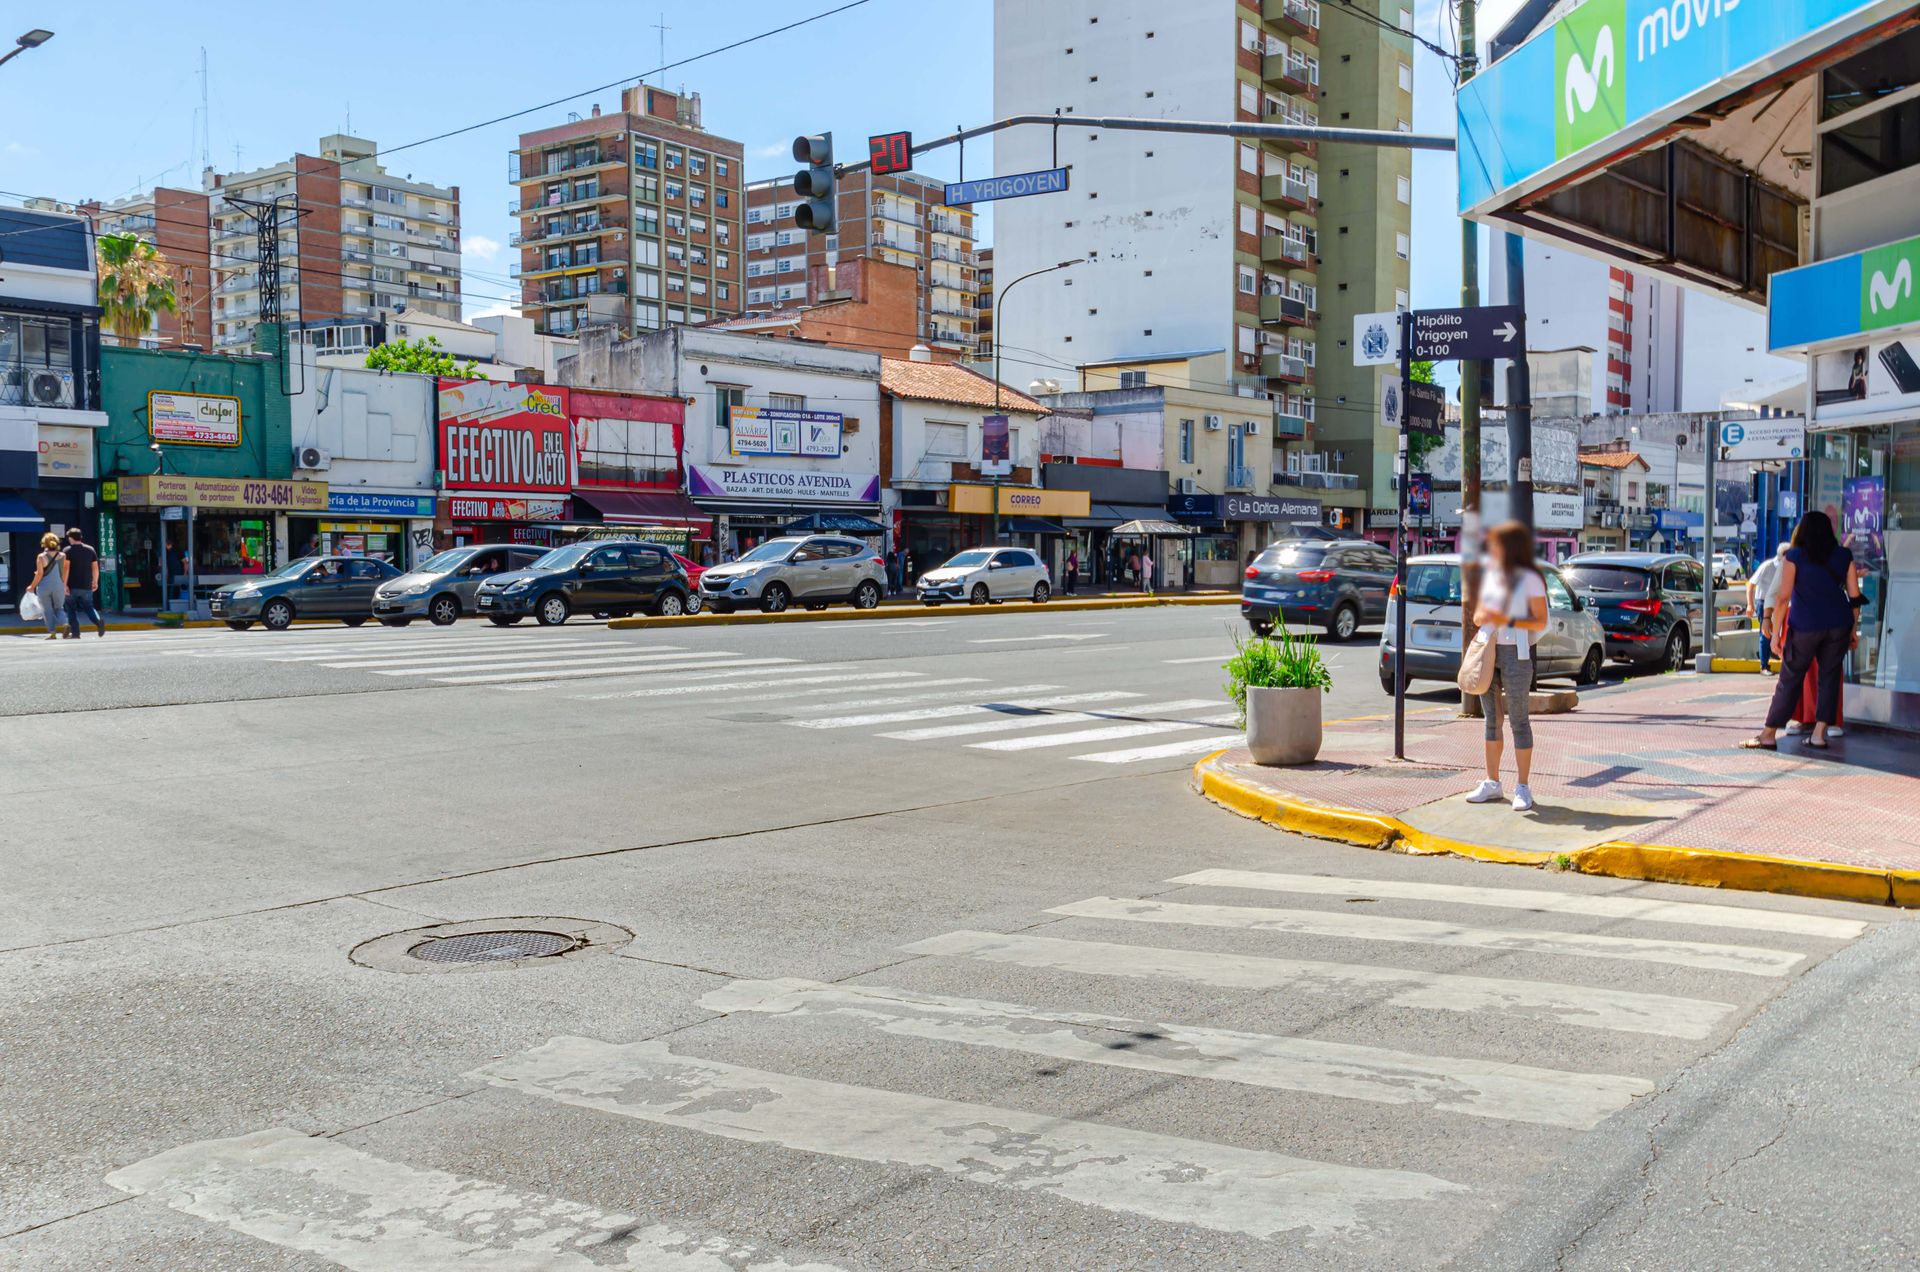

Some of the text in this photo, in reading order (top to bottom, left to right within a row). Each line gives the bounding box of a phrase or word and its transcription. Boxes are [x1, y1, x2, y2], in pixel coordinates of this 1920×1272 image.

[1638, 0, 1738, 62] mov
[870, 133, 908, 174] 20
[951, 172, 1061, 202] H. YRIGOYEN
[1416, 314, 1463, 328] Hipólito
[1416, 330, 1469, 343] Yrigoyen
[1416, 344, 1450, 356] 0-100
[527, 394, 561, 415] Cred
[200, 402, 233, 422] dinfor
[194, 432, 236, 440] 4733-4641
[543, 432, 564, 454] EN EL
[447, 426, 534, 485] EFECTIVO
[536, 452, 566, 486] ACTO
[158, 480, 186, 490] Porteros
[194, 482, 240, 492] Automatización
[723, 471, 851, 489] PLASTICOS AVENIDA
[156, 492, 188, 502] eléctricos
[243, 484, 294, 505] 4733-4641
[776, 487, 793, 495] BAÑO
[208, 494, 235, 503] portones
[296, 495, 321, 506] Vigilancia
[347, 496, 359, 506] de
[361, 496, 370, 506] la
[372, 497, 416, 508] Provincia
[1010, 494, 1041, 504] CORREO
[452, 500, 488, 517] EFECTIVO
[1239, 500, 1318, 516] La Optica Alemana
[514, 528, 547, 540] EFECTIVO
